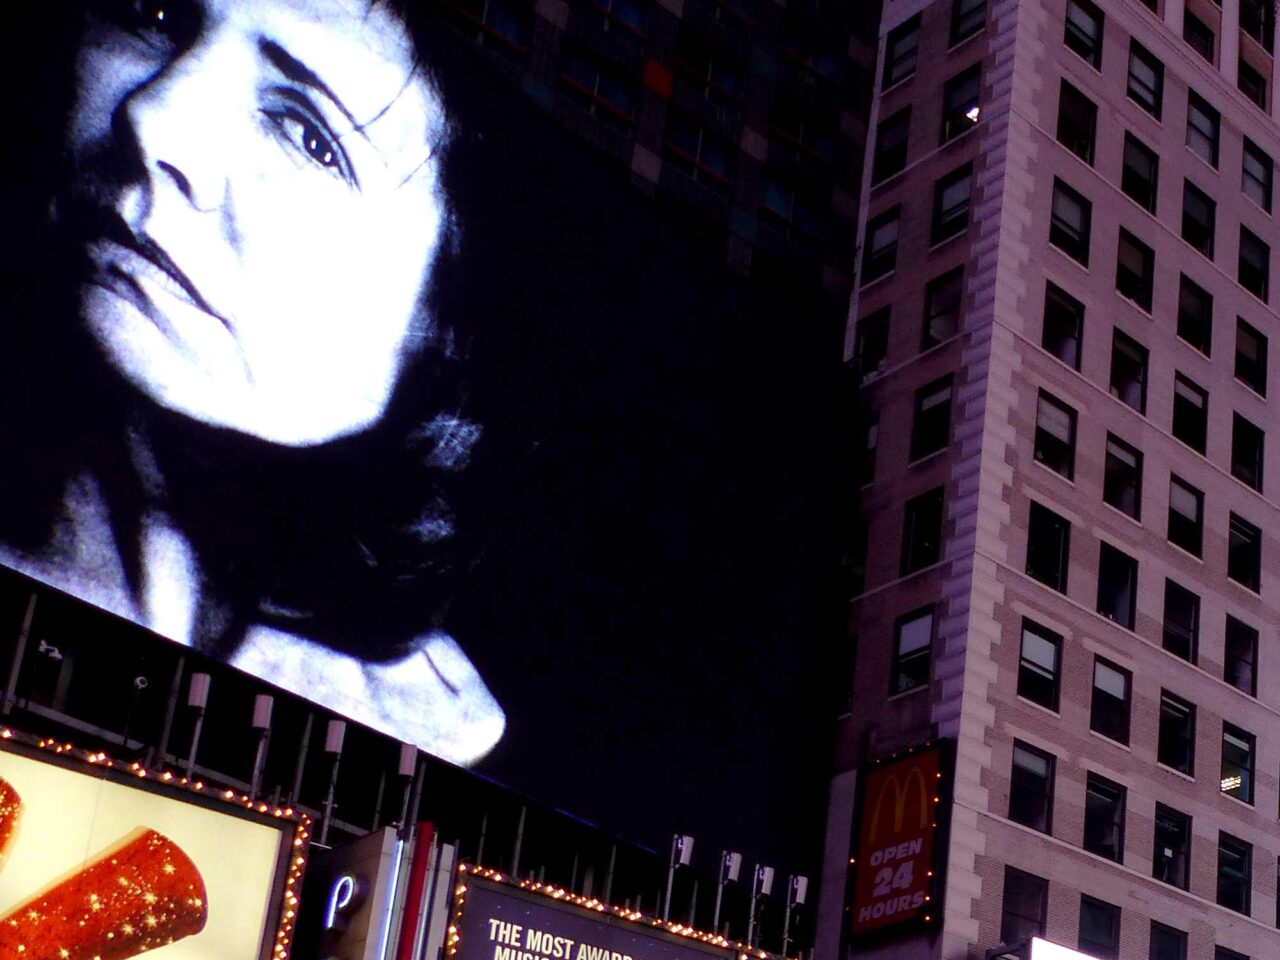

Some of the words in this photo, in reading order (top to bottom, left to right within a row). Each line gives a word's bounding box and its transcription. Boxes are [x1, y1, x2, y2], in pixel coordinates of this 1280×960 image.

[870, 838, 923, 867] OPEN
[872, 860, 914, 898] 24
[858, 891, 926, 922] HOURS
[489, 918, 522, 945] THE
[526, 928, 574, 960] MOST
